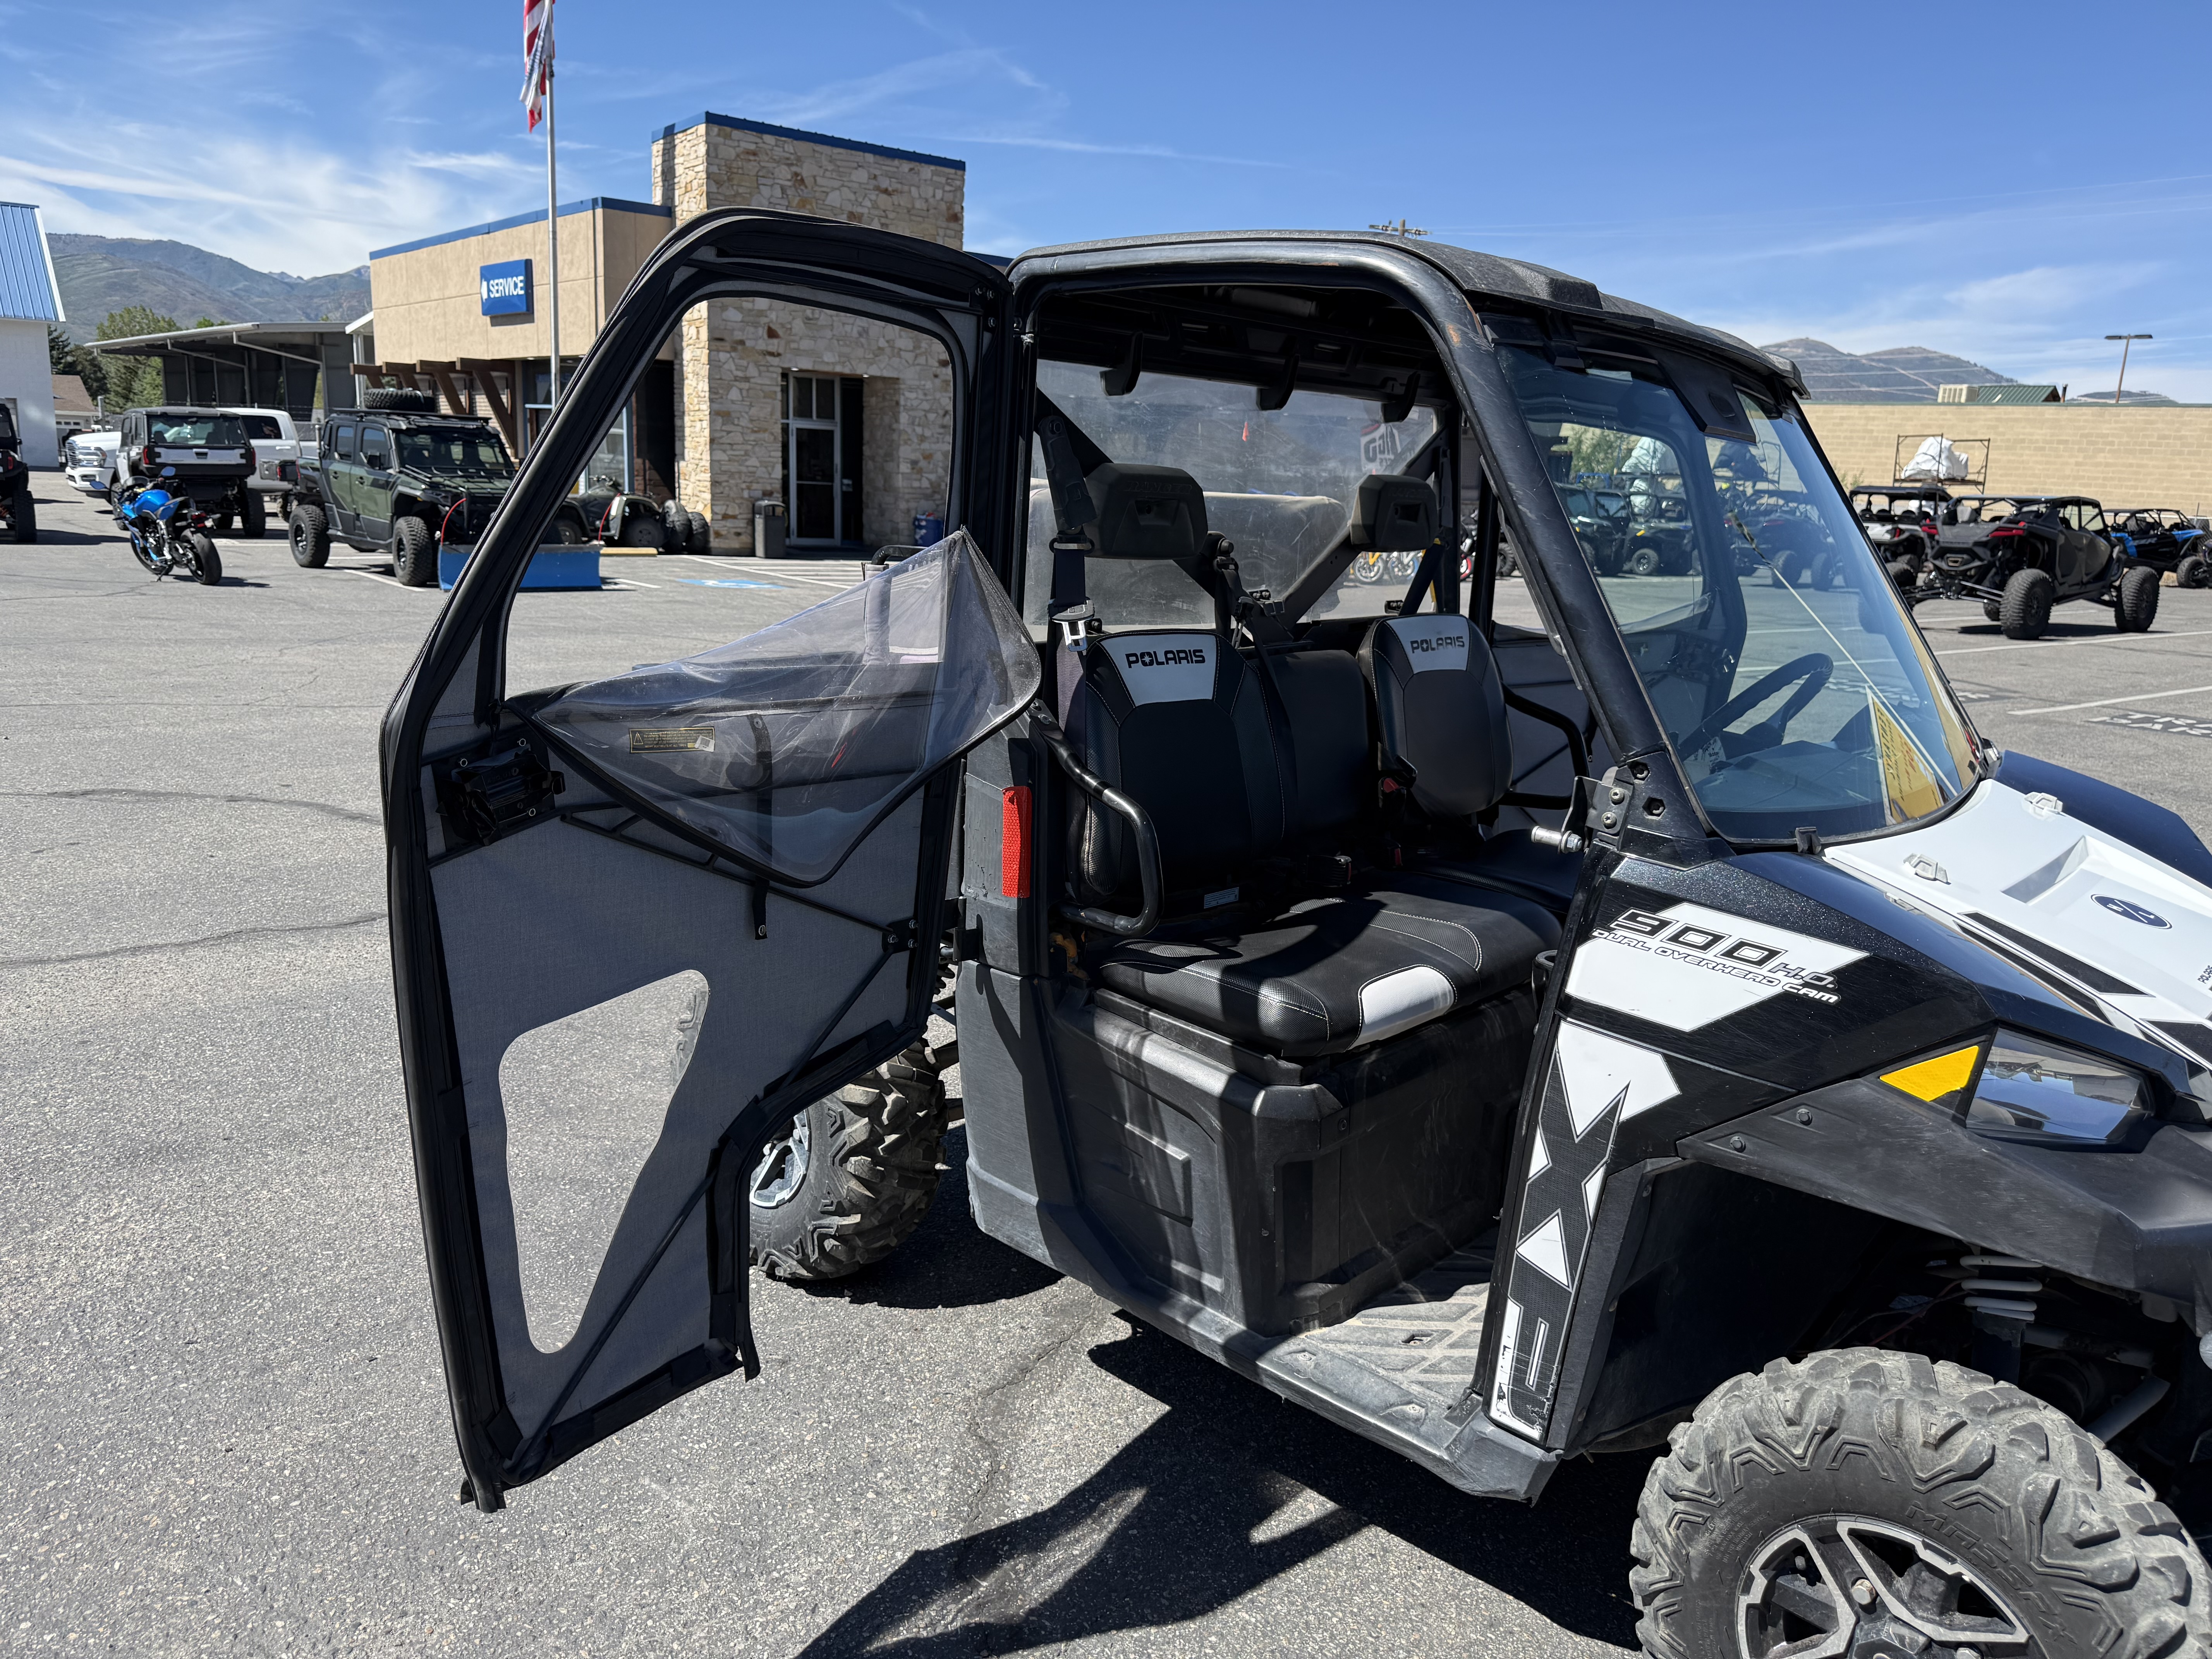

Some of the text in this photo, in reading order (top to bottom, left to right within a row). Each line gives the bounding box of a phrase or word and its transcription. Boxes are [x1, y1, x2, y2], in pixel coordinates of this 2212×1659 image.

[489, 276, 524, 298] SERVICE
[1410, 636, 1465, 654] POLARIS
[1125, 649, 1206, 669] POLARIS
[1609, 907, 1789, 970] 900
[1591, 928, 1840, 1004] DUAL OVERHEAD CAM
[1771, 962, 1837, 989] H.O.
